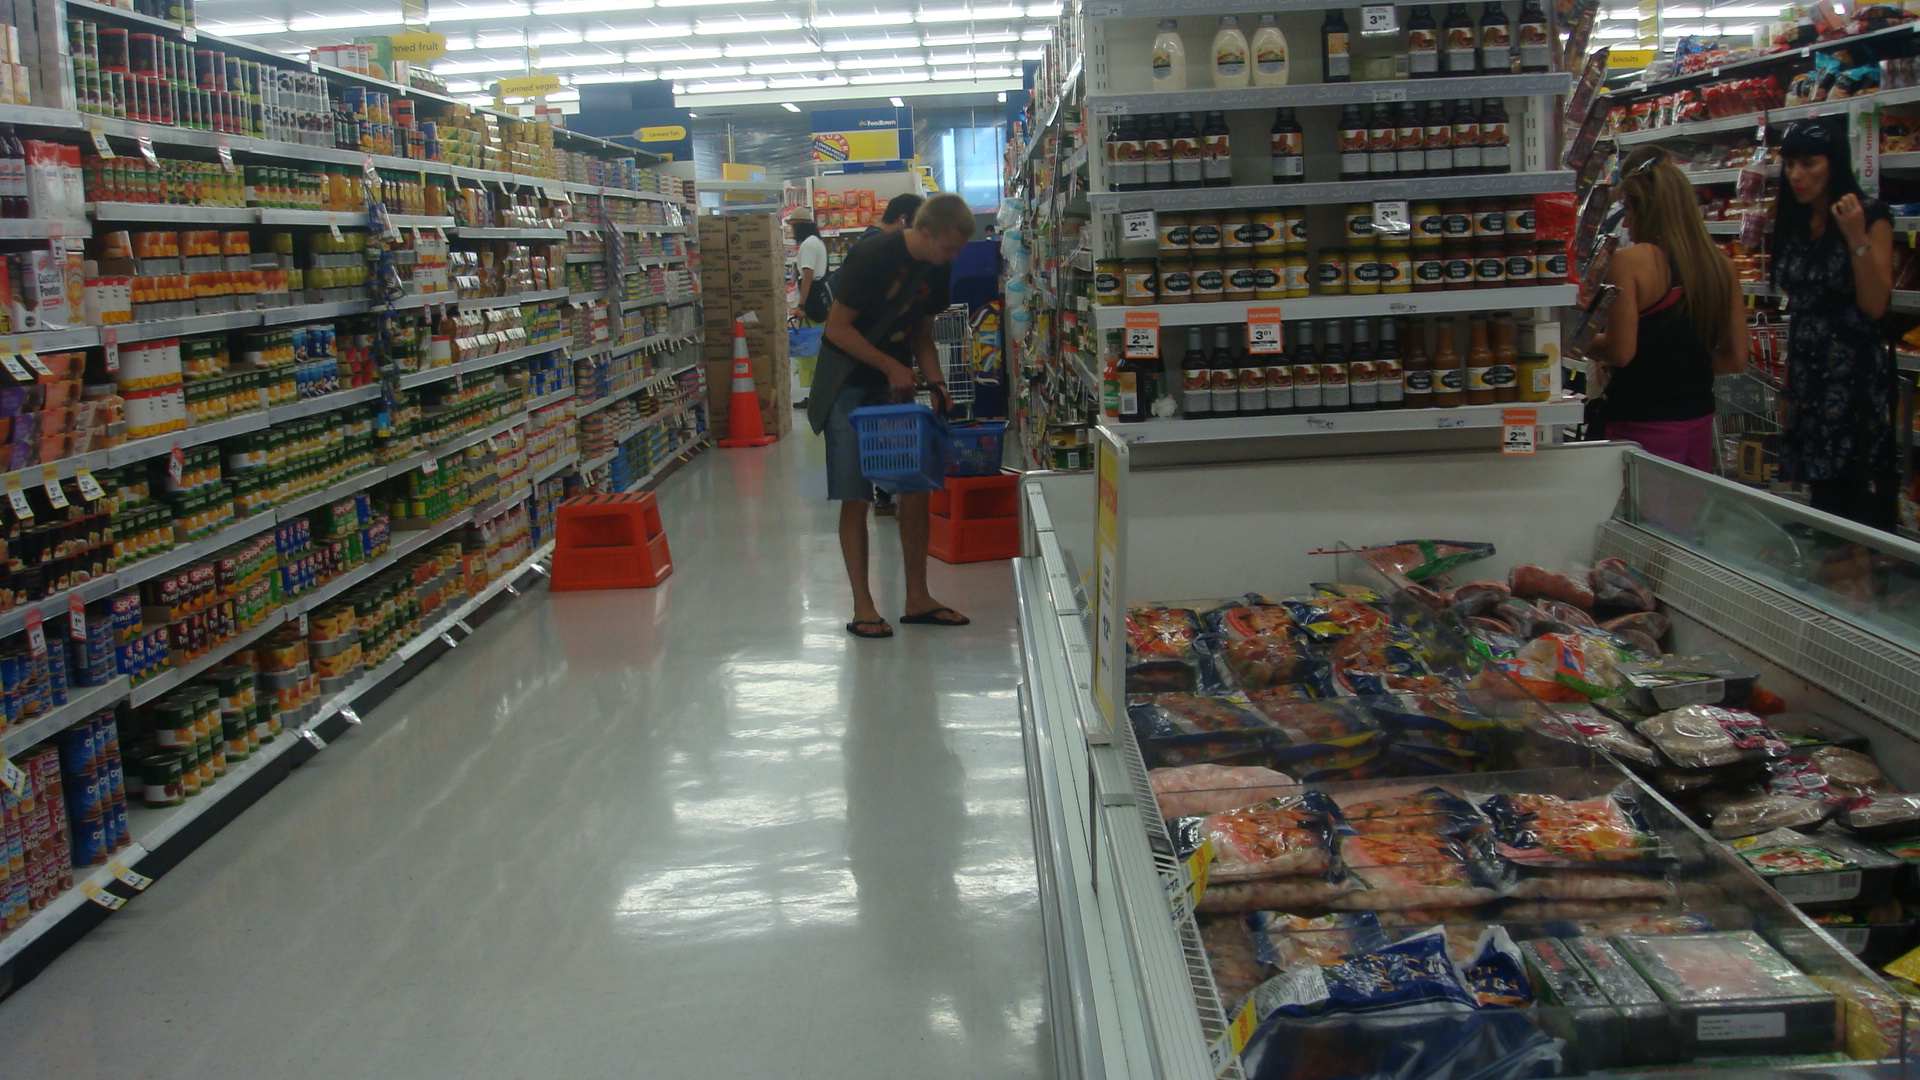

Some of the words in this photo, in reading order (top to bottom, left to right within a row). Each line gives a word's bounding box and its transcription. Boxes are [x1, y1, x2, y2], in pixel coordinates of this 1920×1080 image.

[418, 41, 438, 51] fruit
[506, 85, 533, 94] canned
[535, 82, 558, 94] veges
[866, 119, 897, 127] Foodtown
[1864, 113, 1873, 152] smokin
[820, 133, 849, 152] SUPER
[1864, 154, 1874, 178] Quit
[38, 271, 61, 284] Custard
[40, 285, 61, 297] Powder
